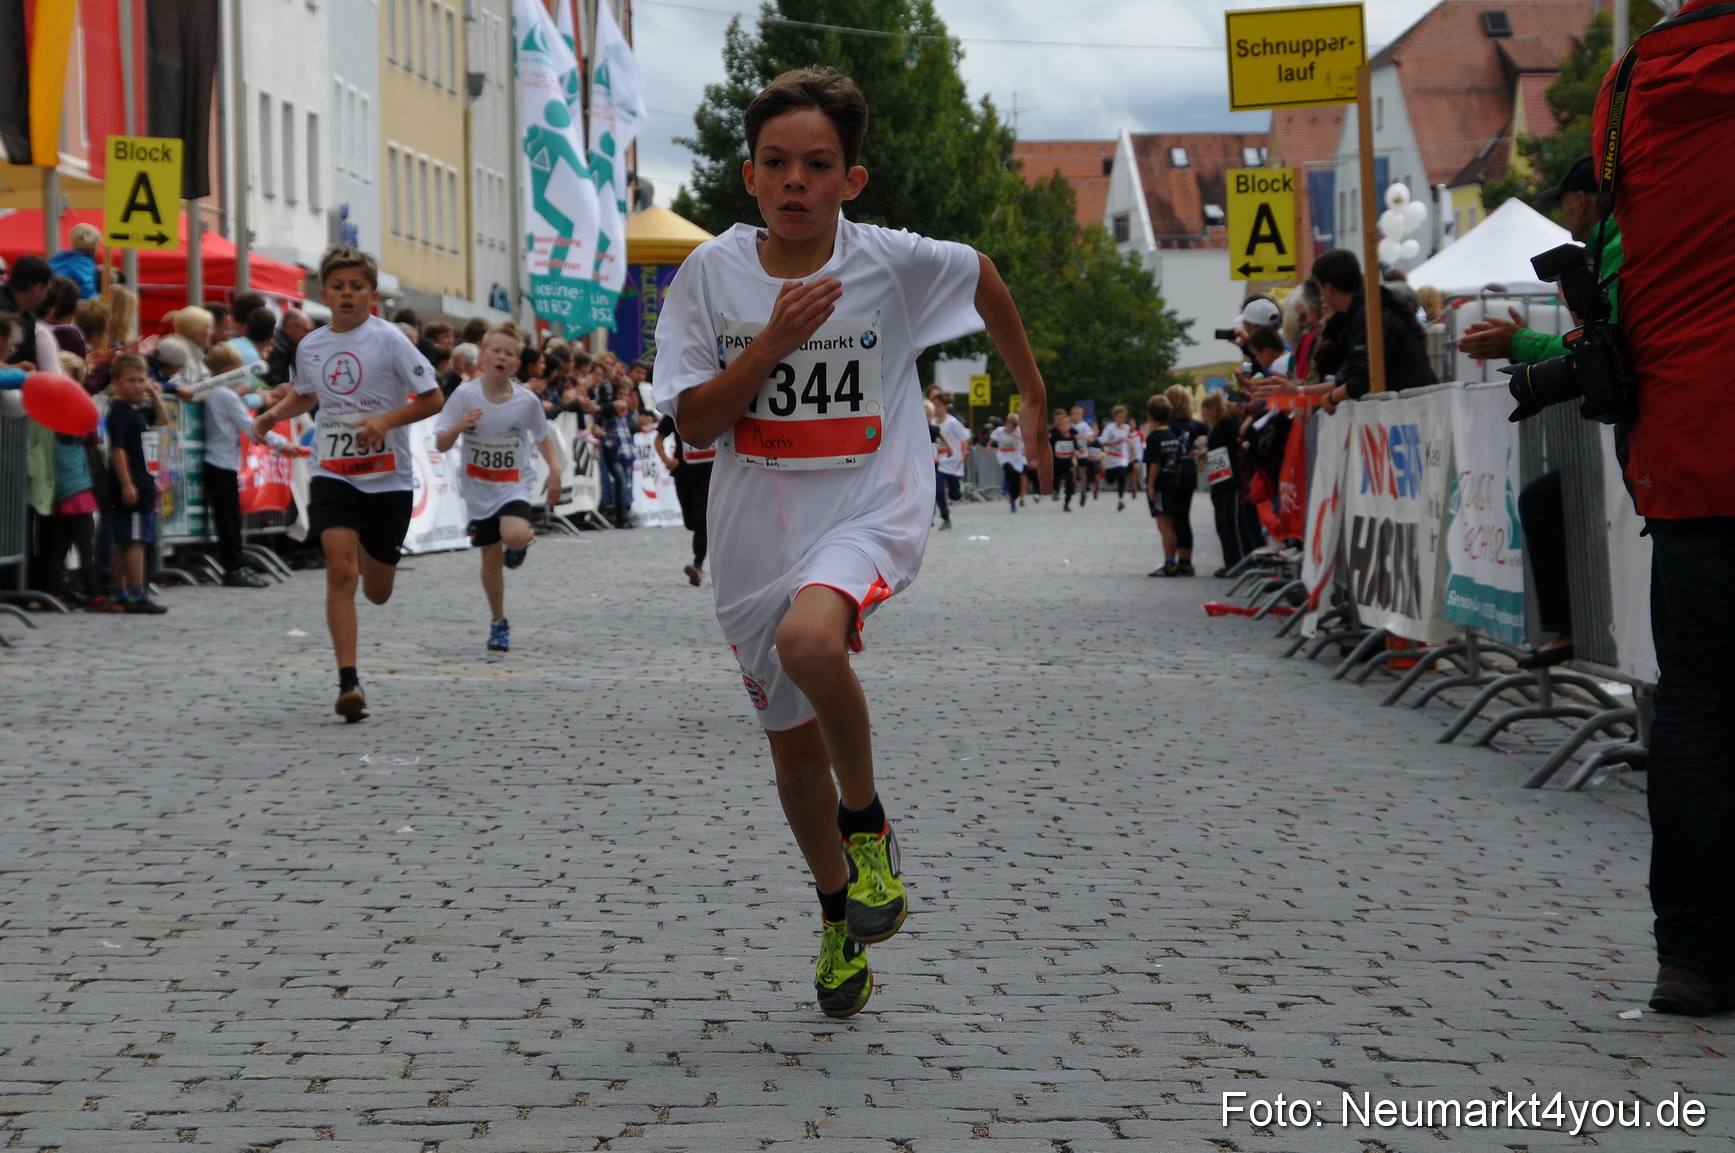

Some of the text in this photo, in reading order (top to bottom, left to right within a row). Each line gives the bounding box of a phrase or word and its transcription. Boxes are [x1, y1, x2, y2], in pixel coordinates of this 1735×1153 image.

[1236, 37, 1355, 58] Schnupper-
[1278, 61, 1316, 82] lauf
[115, 140, 172, 162] Block
[1604, 130, 1617, 180] Nikon
[1236, 174, 1294, 194] Block
[121, 171, 162, 224] A
[1245, 203, 1287, 256] A
[725, 335, 758, 349] PAR
[974, 382, 985, 398] C
[753, 425, 793, 449] Morris
[470, 447, 515, 469] 7386
